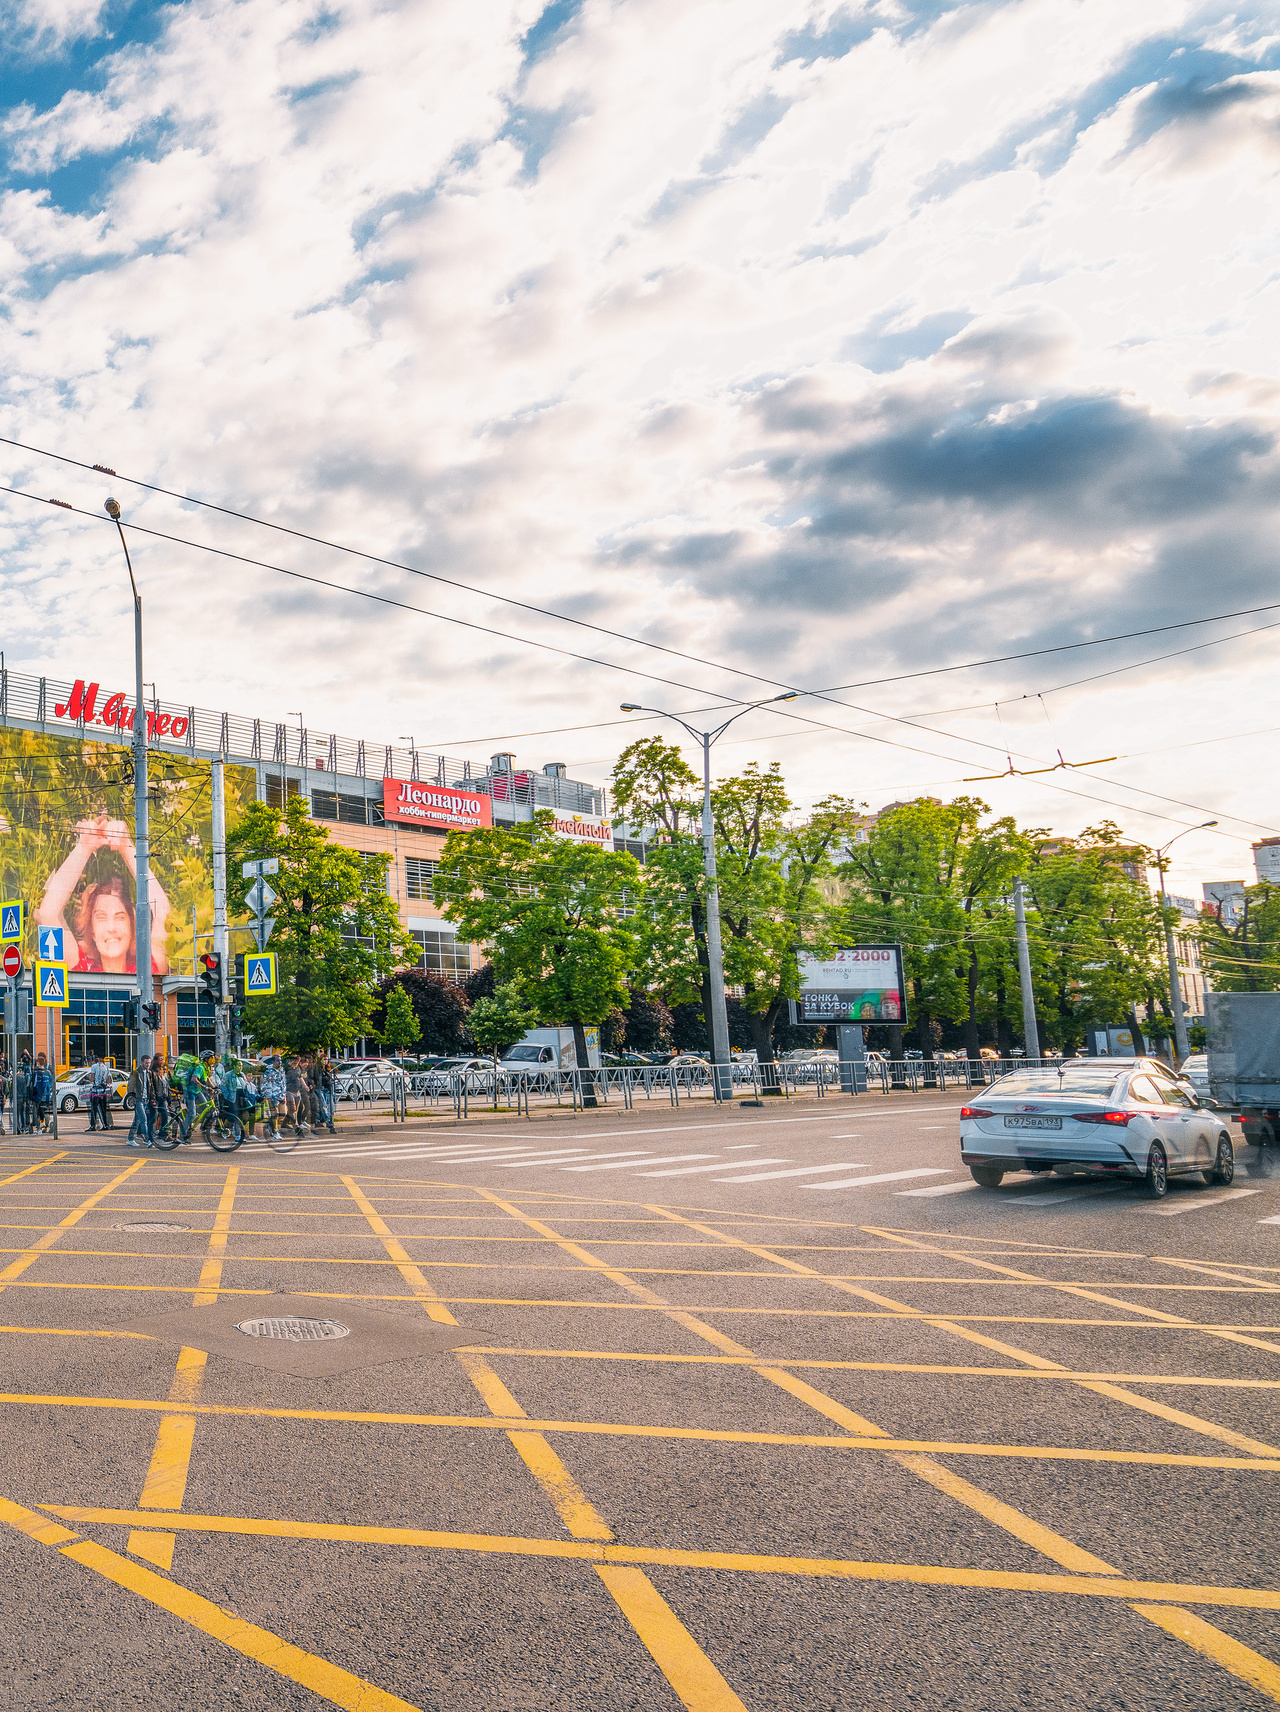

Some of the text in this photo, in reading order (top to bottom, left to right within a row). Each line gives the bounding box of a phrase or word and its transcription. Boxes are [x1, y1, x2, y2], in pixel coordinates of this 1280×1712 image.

[398, 783, 481, 816] Леонардо
[398, 806, 481, 825] хобби-гипермаркет
[552, 815, 612, 840] мейный
[804, 1002, 855, 1010] ЗА КУБОК
[805, 994, 839, 1002] ГОНКА
